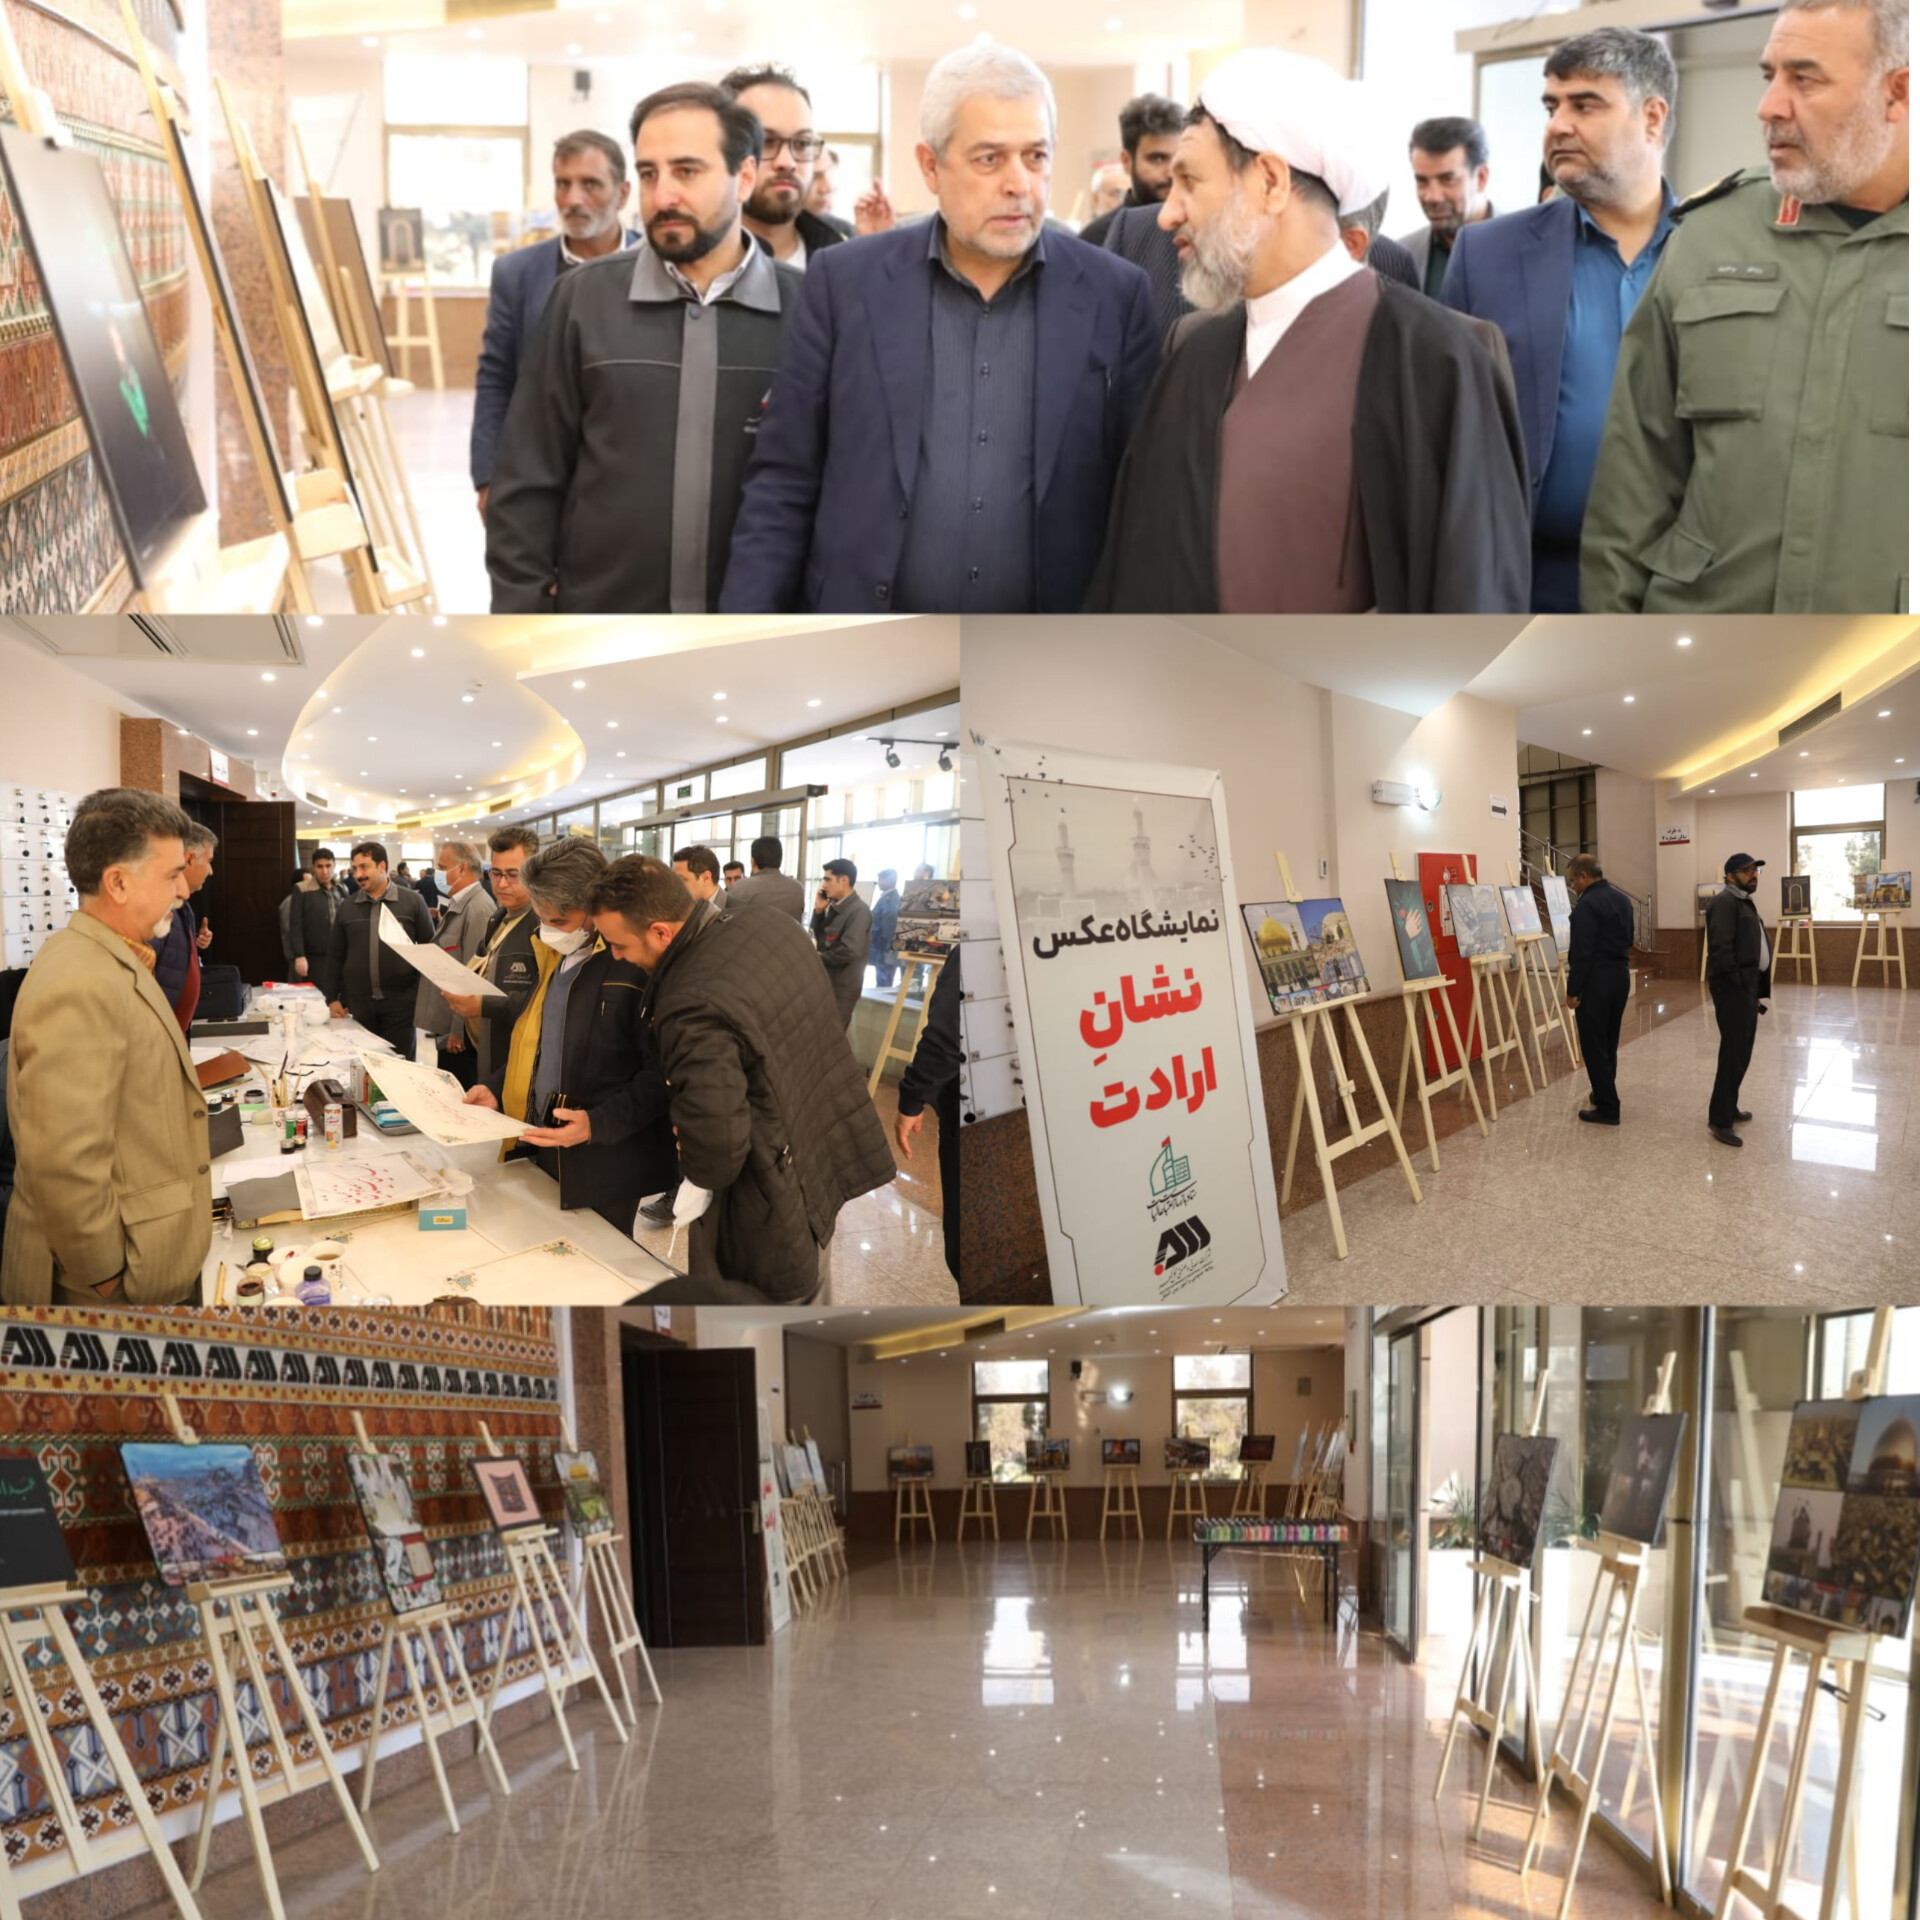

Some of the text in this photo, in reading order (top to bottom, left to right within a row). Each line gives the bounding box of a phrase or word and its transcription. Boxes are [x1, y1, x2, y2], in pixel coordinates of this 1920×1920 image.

[1033, 910, 1219, 960] نمایشگاه عکس
[1090, 1046, 1218, 1129] ارادت
